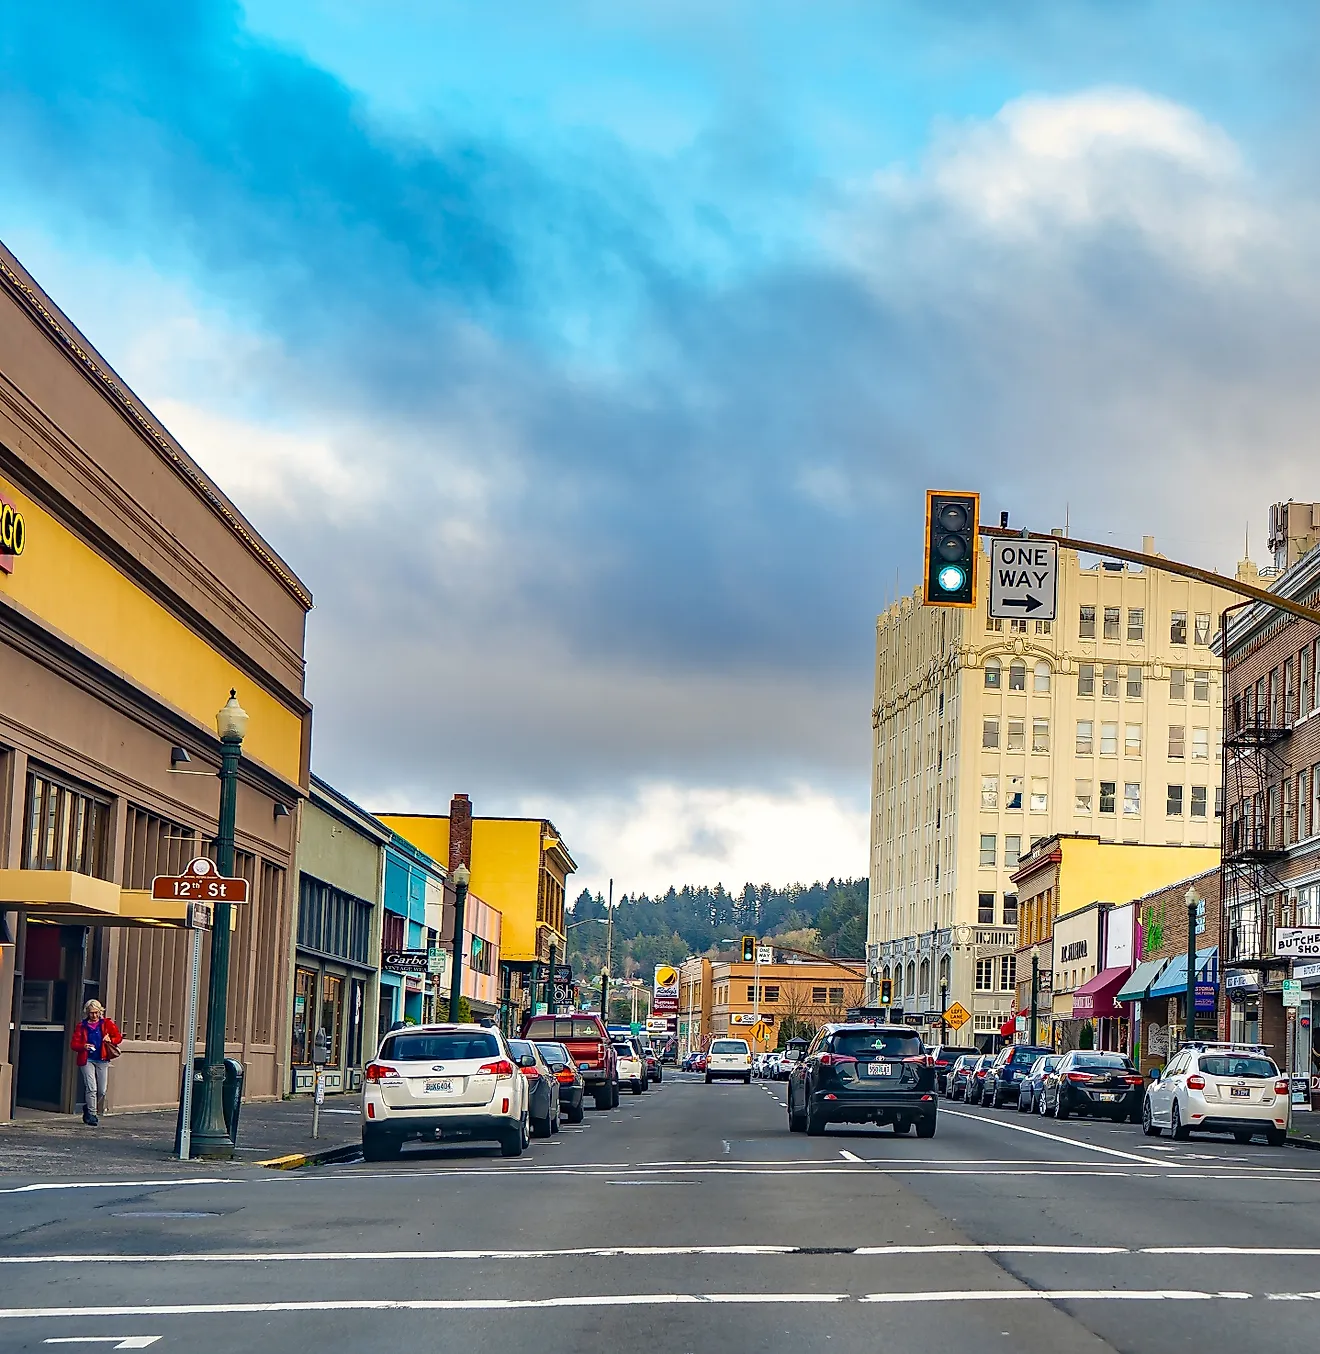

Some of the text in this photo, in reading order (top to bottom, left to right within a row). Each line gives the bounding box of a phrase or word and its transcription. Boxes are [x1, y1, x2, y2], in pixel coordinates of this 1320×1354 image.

[1001, 547, 1048, 566] ONE
[999, 569, 1049, 588] WAY
[173, 882, 227, 897] 12th St
[386, 954, 428, 966] Garbo
